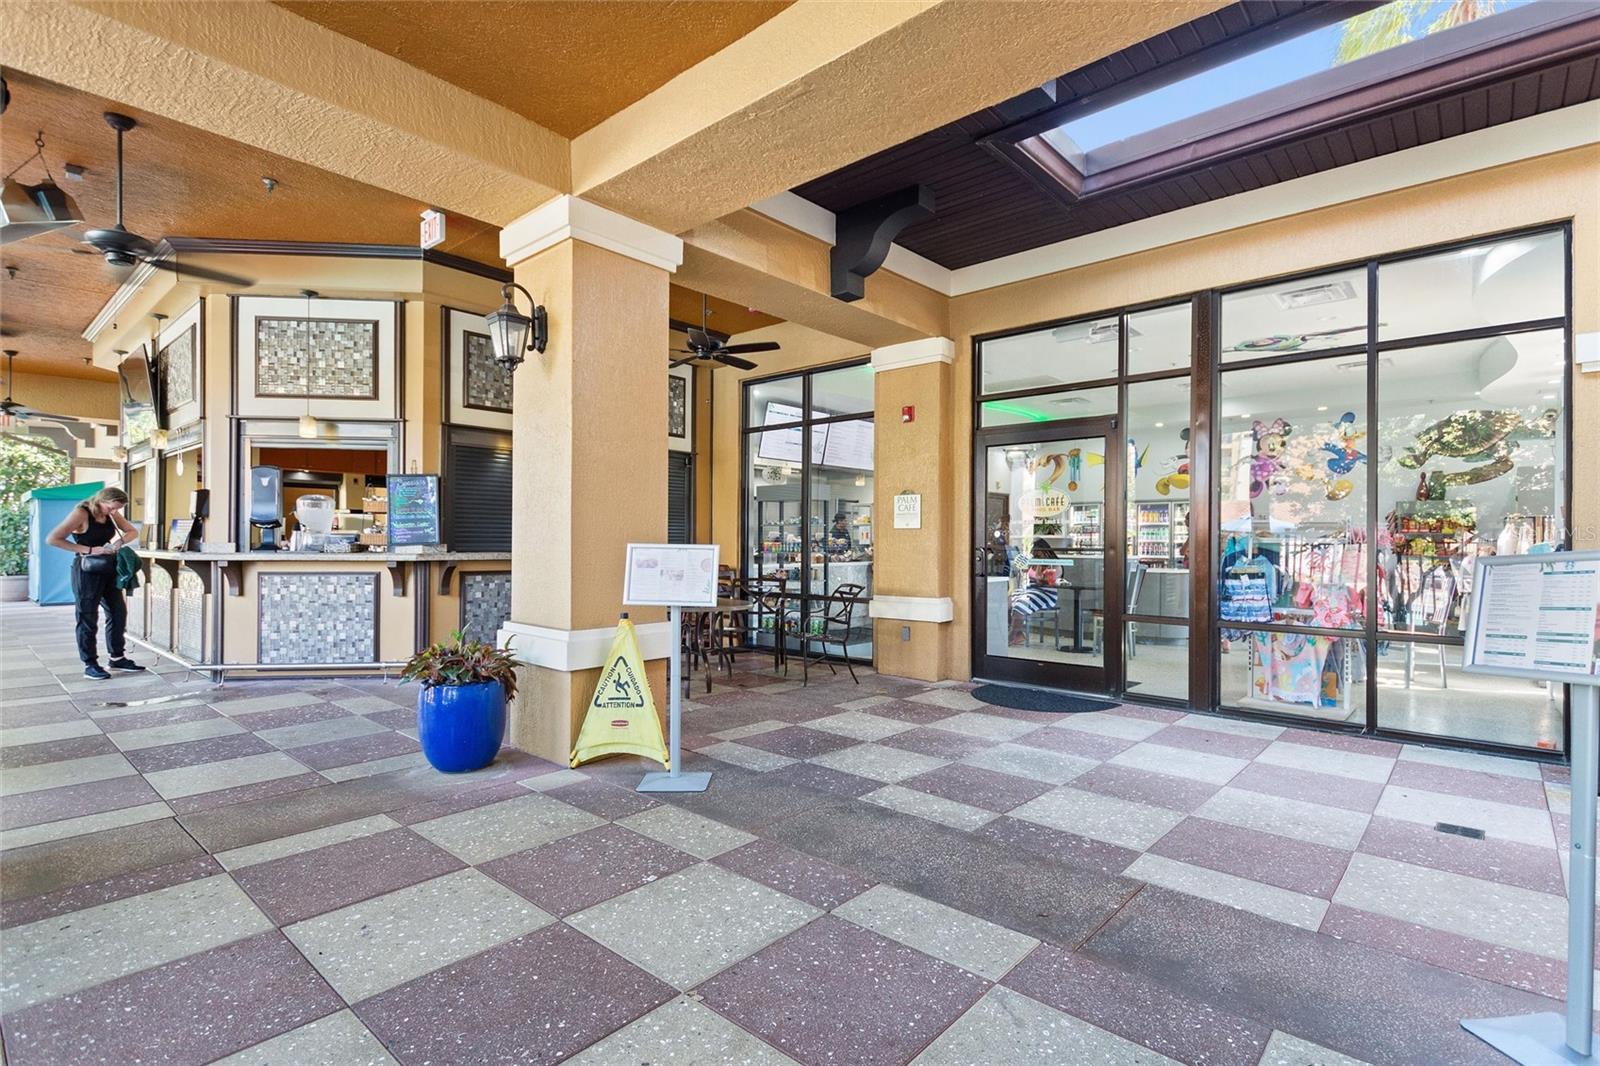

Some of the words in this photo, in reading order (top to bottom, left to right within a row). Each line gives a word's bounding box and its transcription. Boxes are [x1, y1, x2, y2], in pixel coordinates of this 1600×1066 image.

[424, 217, 438, 243] EXIT
[896, 496, 917, 504] PALM
[1045, 494, 1064, 506] CAFÉ
[597, 666, 616, 695] CAUTION
[625, 667, 642, 695] CUIDADO
